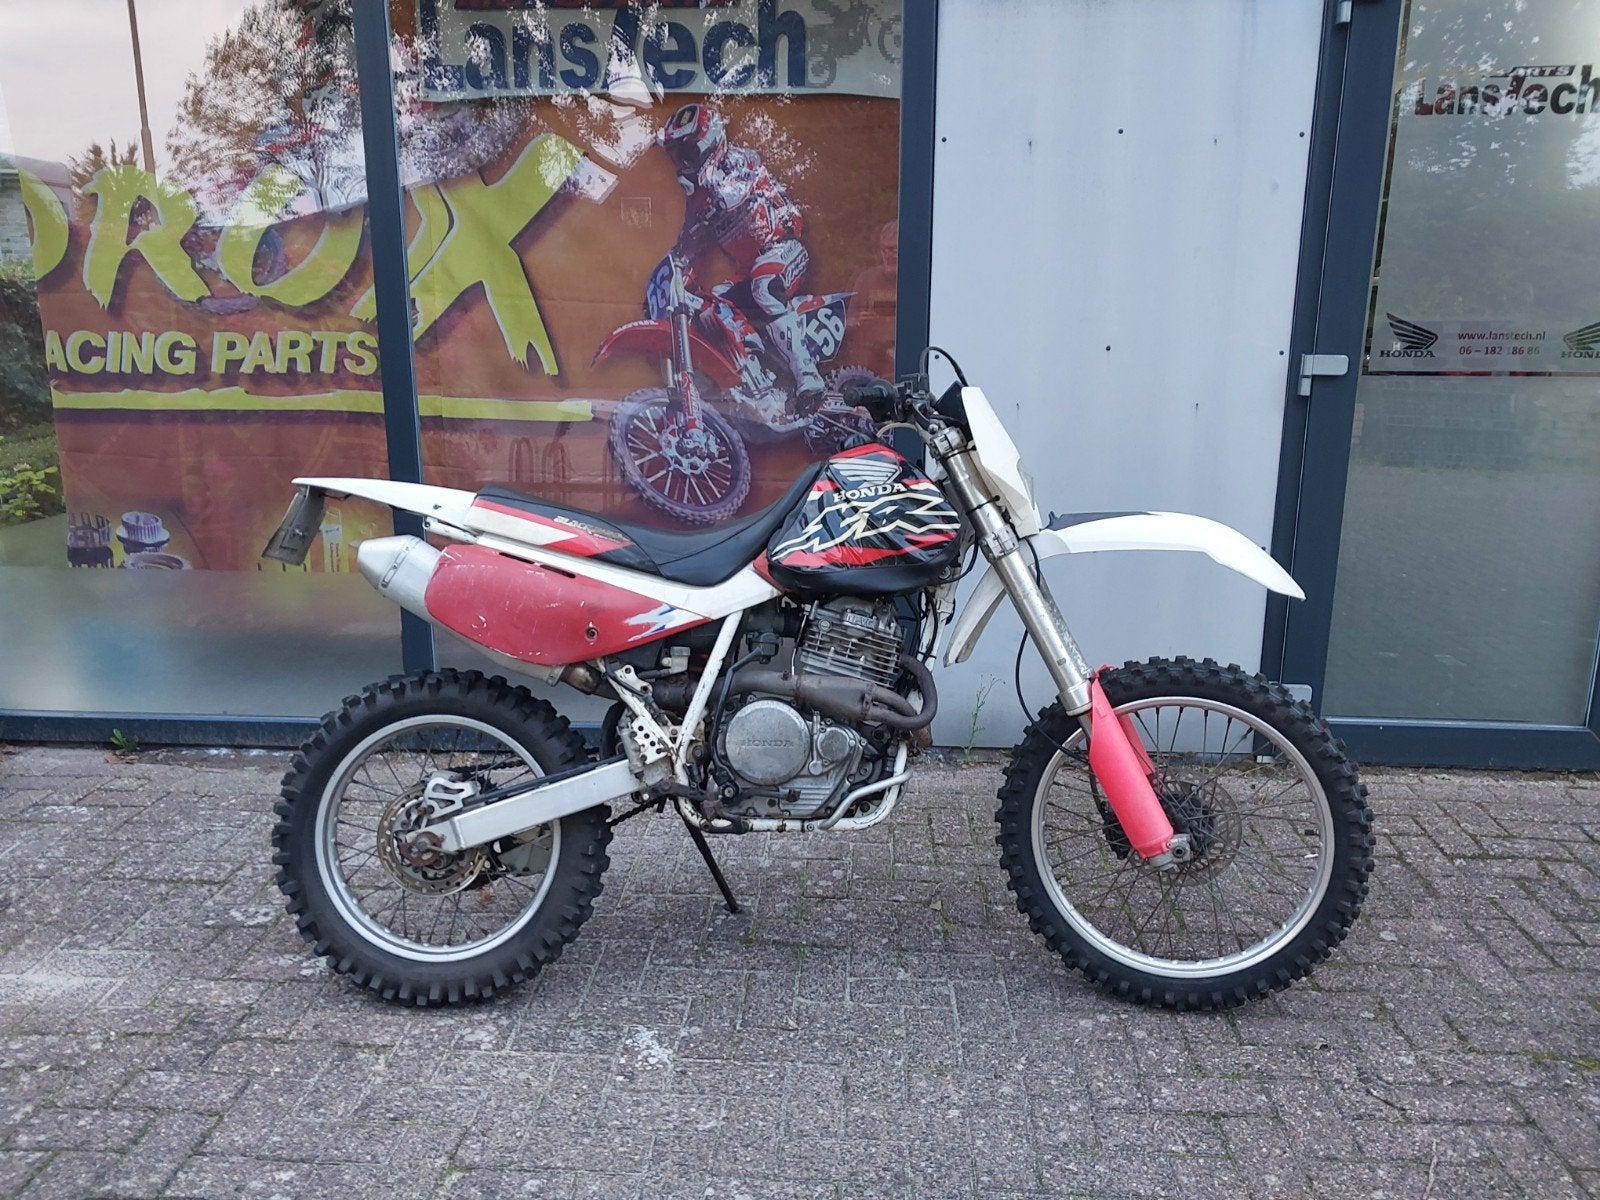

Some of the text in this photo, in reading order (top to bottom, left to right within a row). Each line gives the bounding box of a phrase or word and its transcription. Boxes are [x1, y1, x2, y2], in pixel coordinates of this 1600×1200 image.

[211, 330, 379, 376] PARTS
[1380, 349, 1436, 359] HONDA
[832, 482, 907, 503] HONDA
